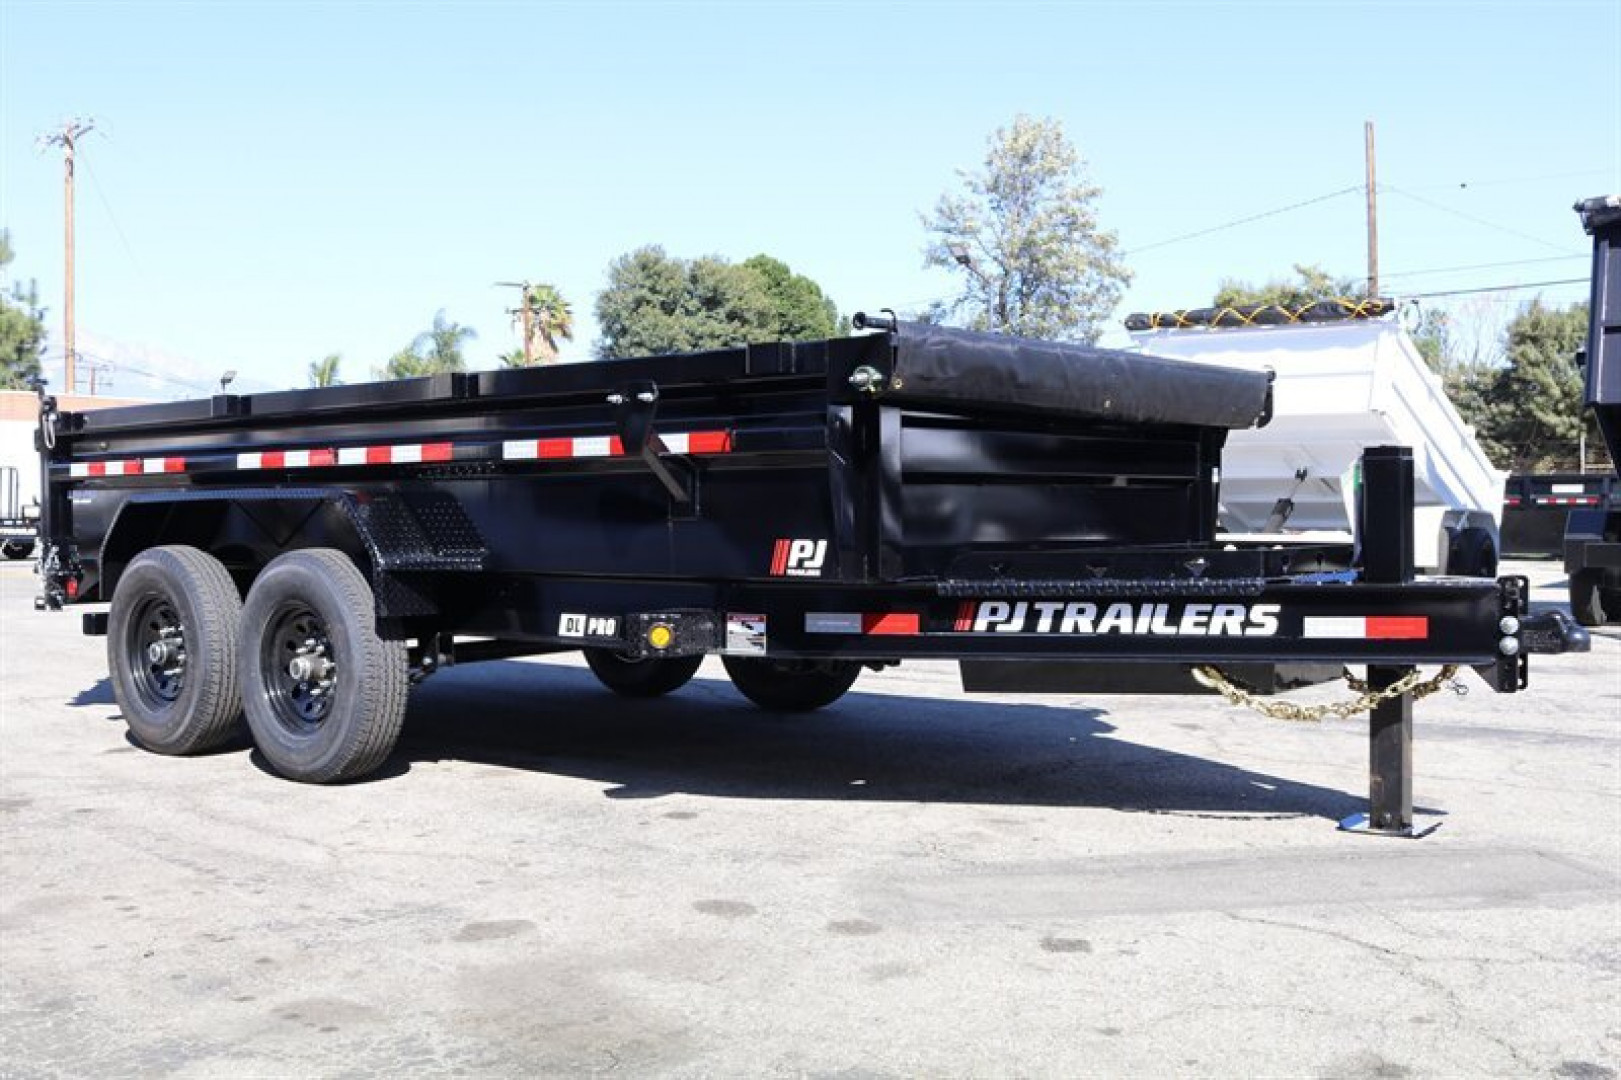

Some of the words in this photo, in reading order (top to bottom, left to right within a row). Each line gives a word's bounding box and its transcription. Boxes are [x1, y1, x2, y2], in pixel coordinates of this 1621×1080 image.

[788, 539, 827, 568] PJ
[974, 601, 1028, 632] PJ
[1034, 602, 1281, 636] TRAILERS
